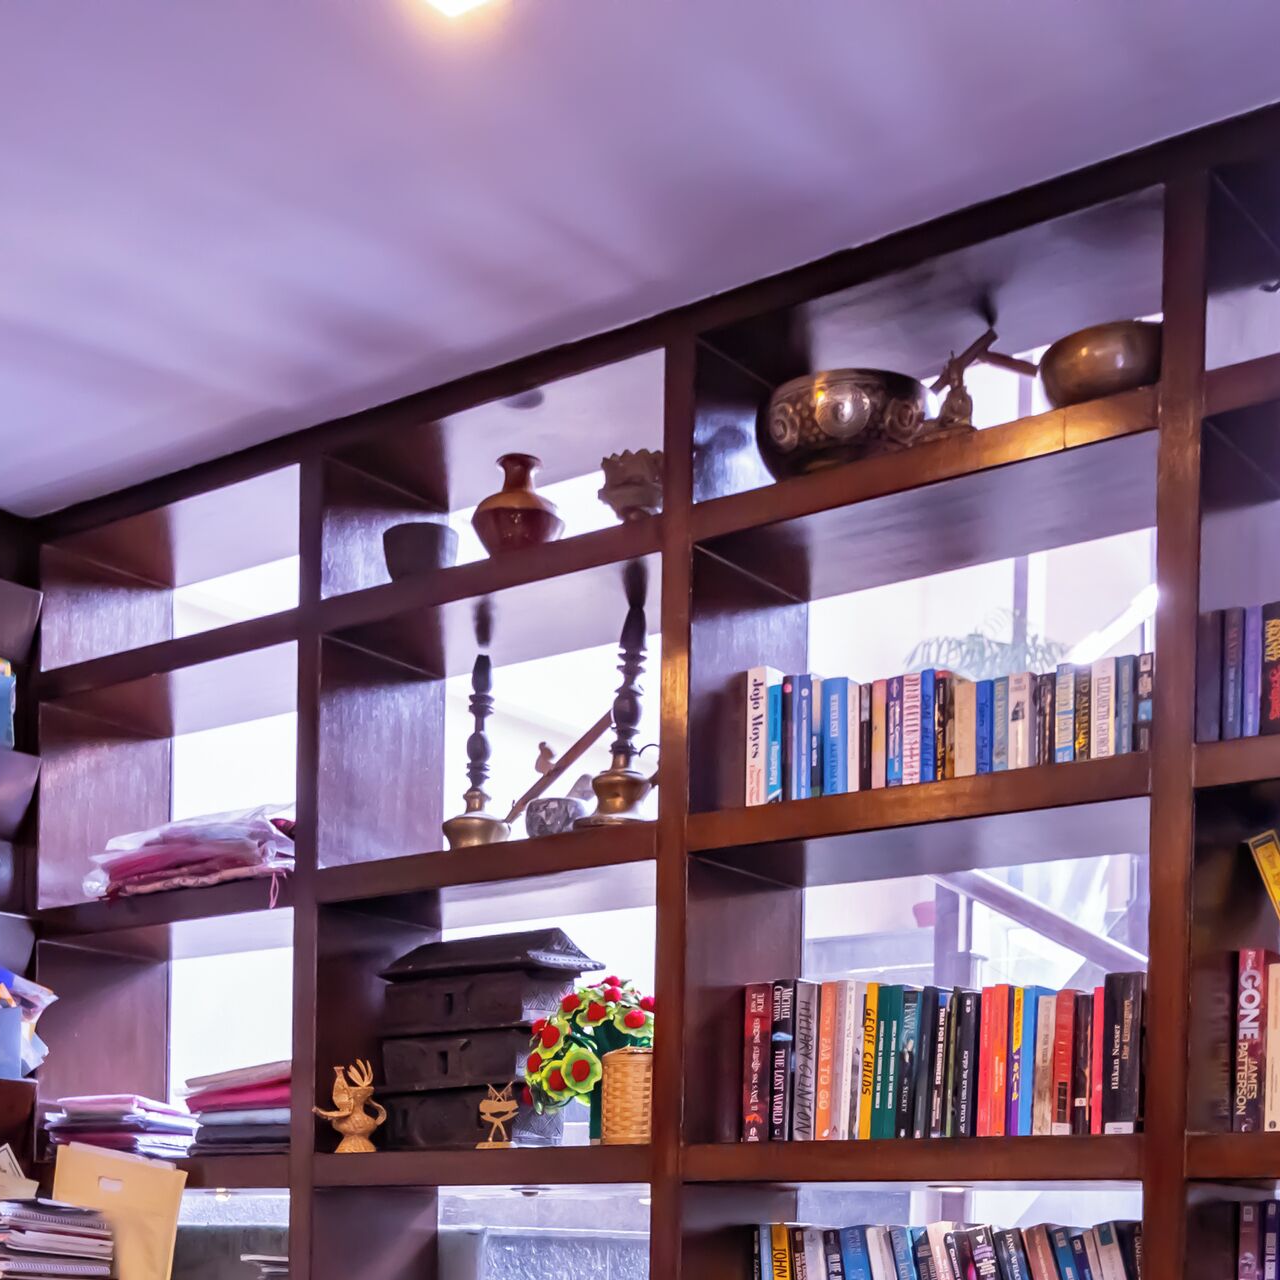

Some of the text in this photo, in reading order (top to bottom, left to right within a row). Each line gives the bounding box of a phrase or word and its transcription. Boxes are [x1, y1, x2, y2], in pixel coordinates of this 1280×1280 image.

[750, 679, 764, 759] Jojo Moyes
[773, 986, 784, 1022] CRICHTON
[781, 987, 793, 1019] MICHAEL
[938, 1008, 946, 1027] THAI
[1238, 970, 1262, 1041] GONE
[862, 1008, 875, 1096] GEOFF CHILDS
[937, 1027, 945, 1041] FOR
[818, 1037, 832, 1110] FAR TO GO
[934, 1044, 944, 1085] BEGINNERS
[1111, 1025, 1121, 1090] Håkan Nesser
[772, 1049, 786, 1125] THE LOST WORLD
[1235, 1042, 1248, 1116] PATTERSON
[1247, 1058, 1258, 1099] JAMES
[773, 1248, 787, 1278] JOHN
[1005, 1234, 1016, 1252] JANE
[827, 1254, 842, 1274] BLUE
